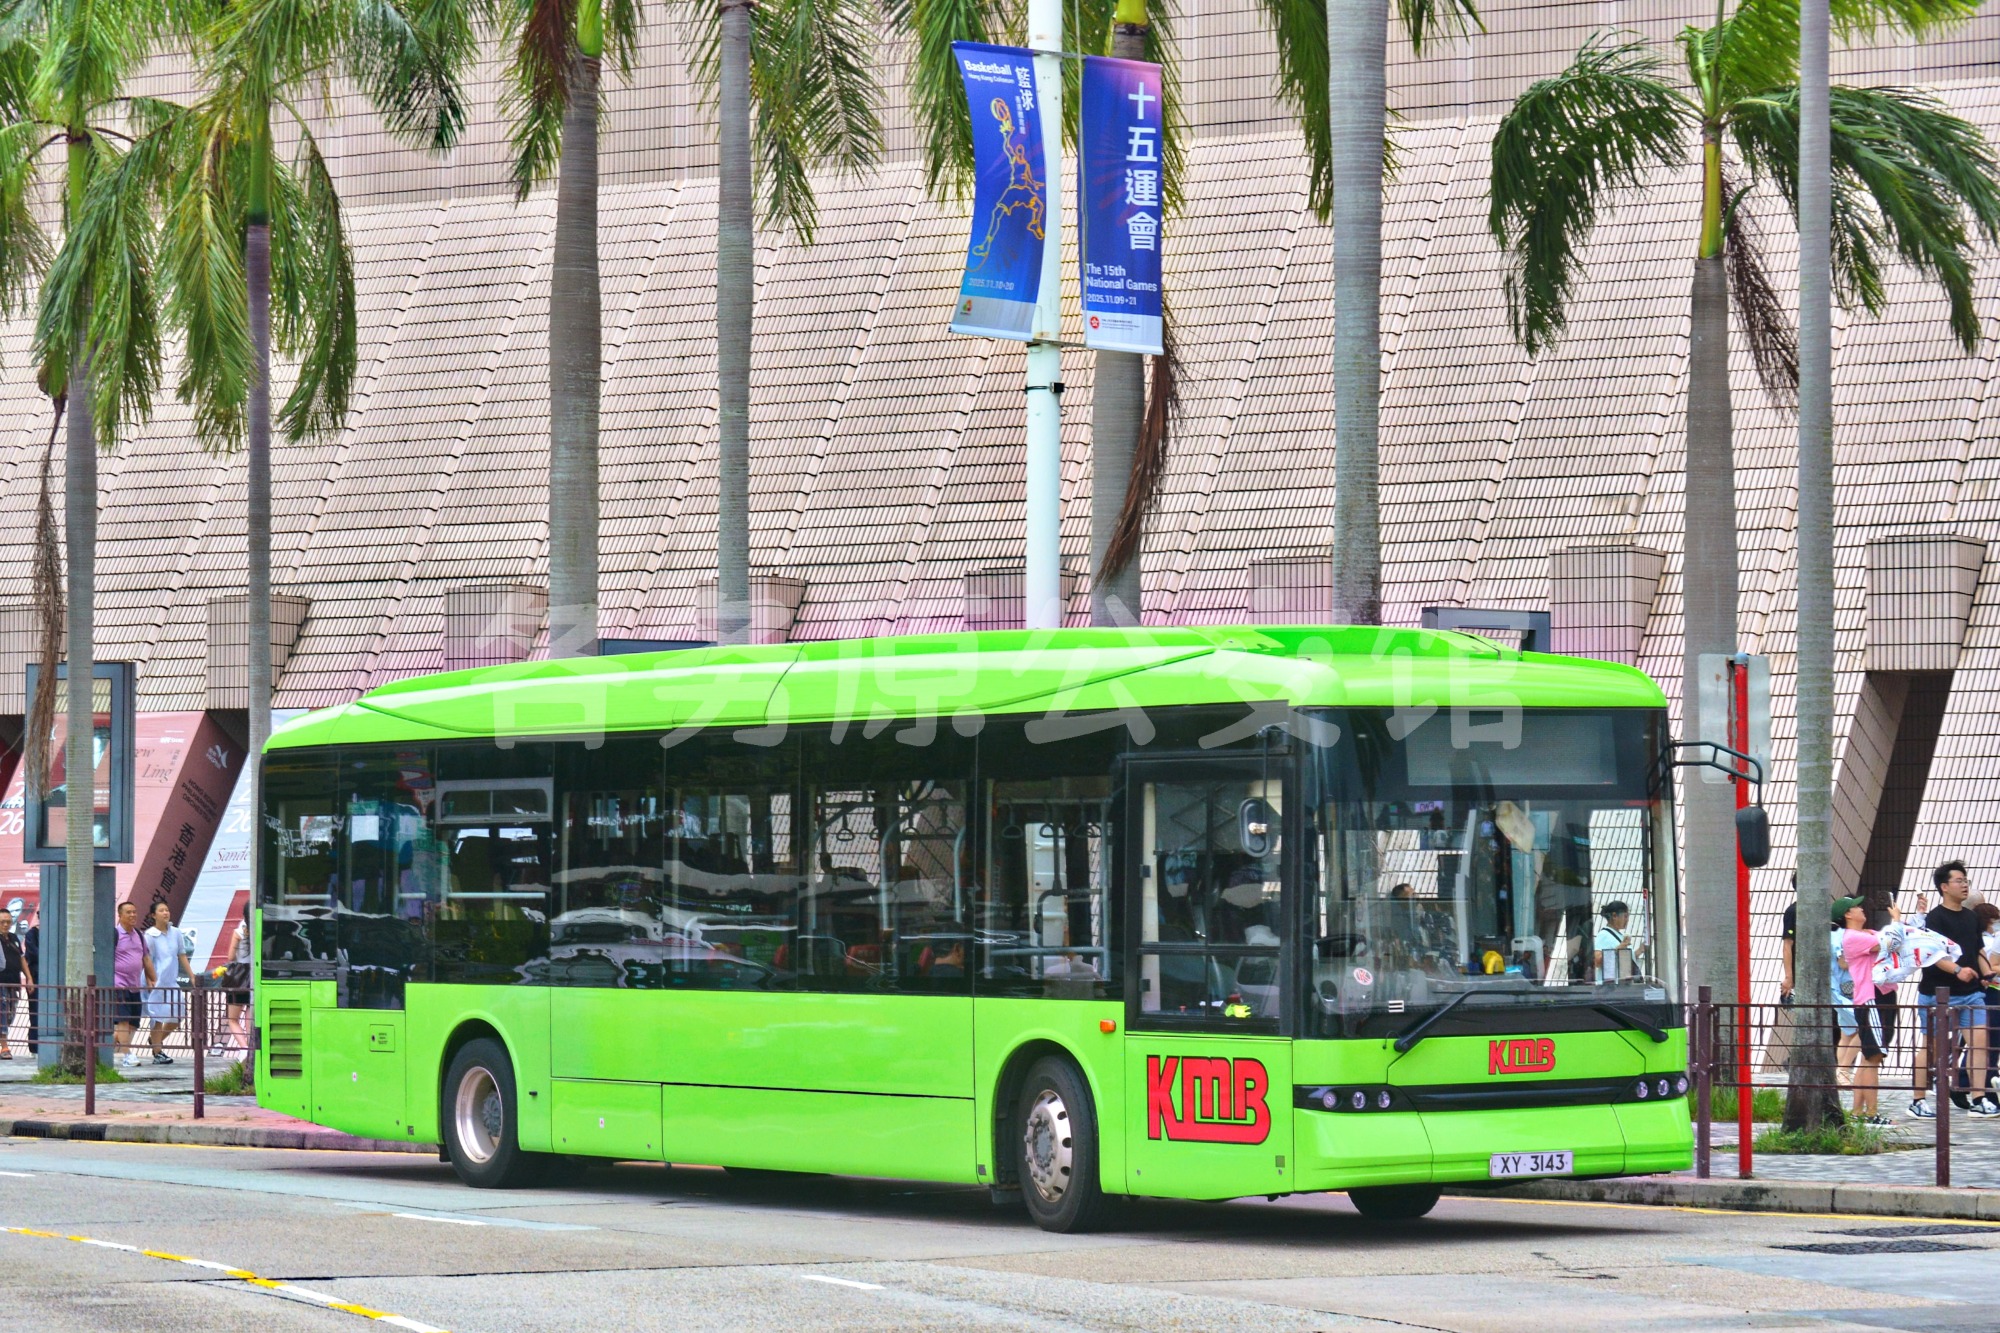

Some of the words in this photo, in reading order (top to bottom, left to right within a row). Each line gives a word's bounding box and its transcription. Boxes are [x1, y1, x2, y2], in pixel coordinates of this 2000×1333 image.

[963, 60, 1012, 76] Basketball
[1015, 66, 1035, 111] 籃球
[1124, 81, 1159, 252] 十五運會
[1086, 263, 1101, 275] The
[1103, 265, 1126, 277] 15th
[1086, 277, 1125, 290] National
[1126, 279, 1158, 292] Games
[142, 763, 174, 784] Ling
[0, 811, 24, 835] 26
[1488, 1037, 1557, 1076] KMB
[1146, 1055, 1272, 1146] KMB
[1500, 1156, 1522, 1174] XY
[1529, 1153, 1566, 1172] 3143
